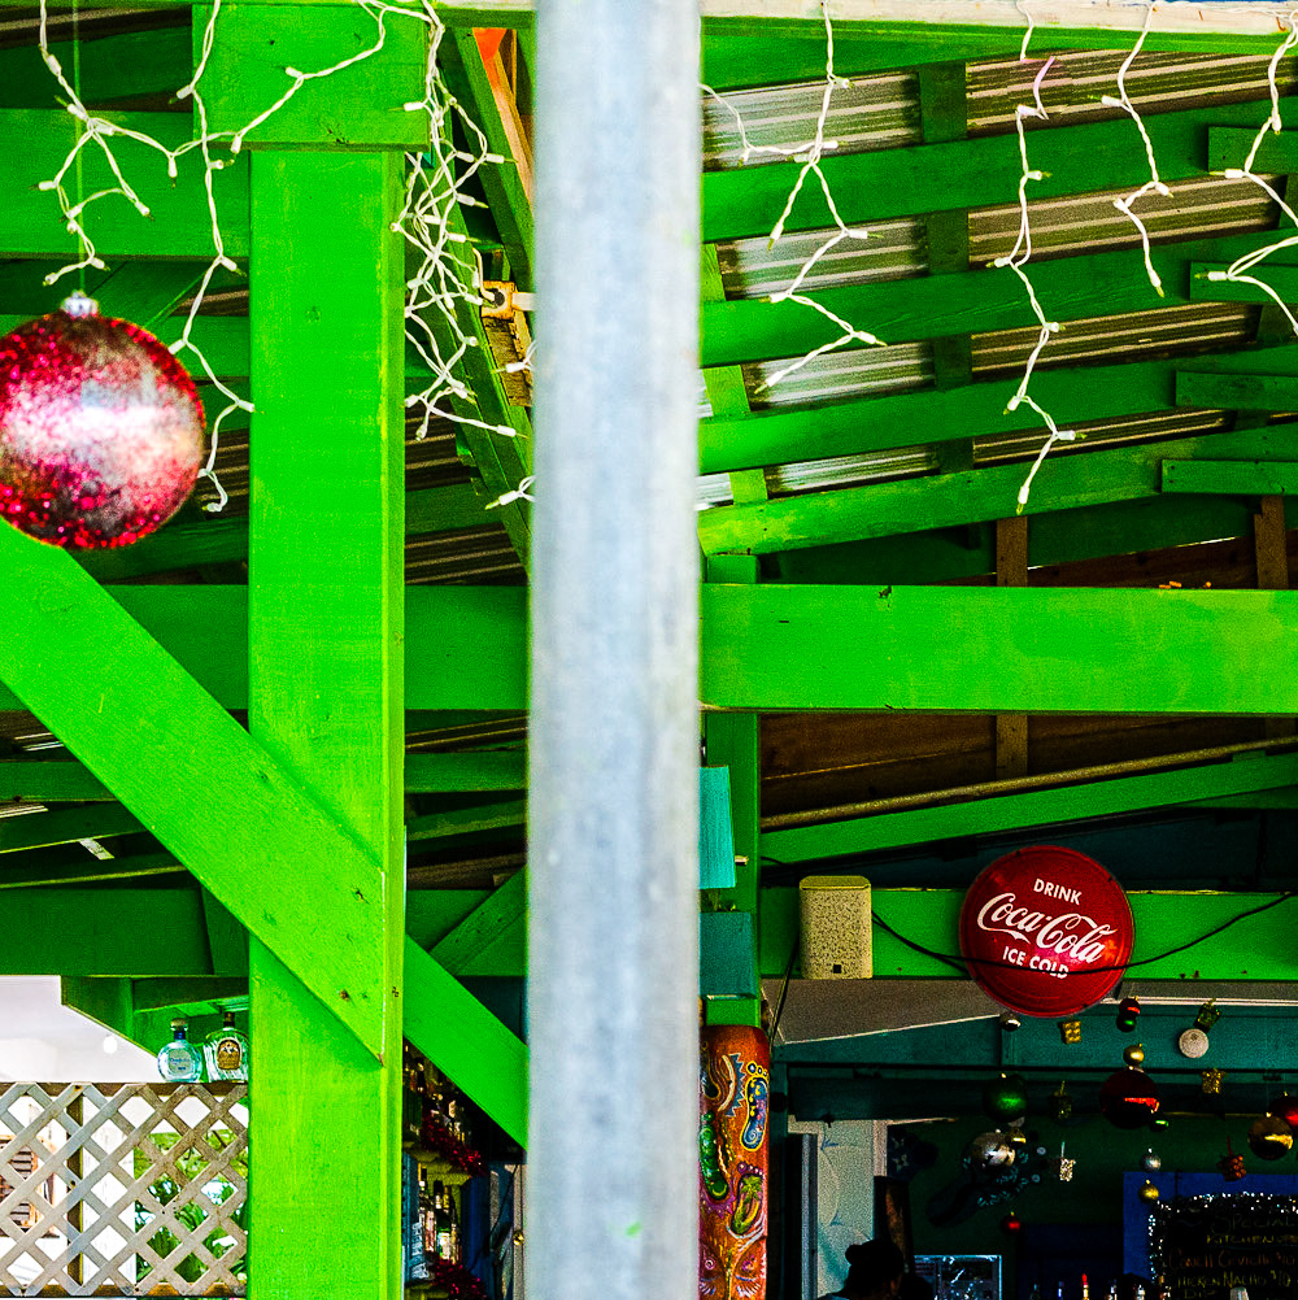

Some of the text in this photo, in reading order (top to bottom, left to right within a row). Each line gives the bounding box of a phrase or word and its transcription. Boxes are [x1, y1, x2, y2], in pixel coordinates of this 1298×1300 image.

[1033, 878, 1082, 905] DRINK
[977, 892, 1118, 963] Coca-Cola
[1003, 946, 1069, 979] ICE COLD
